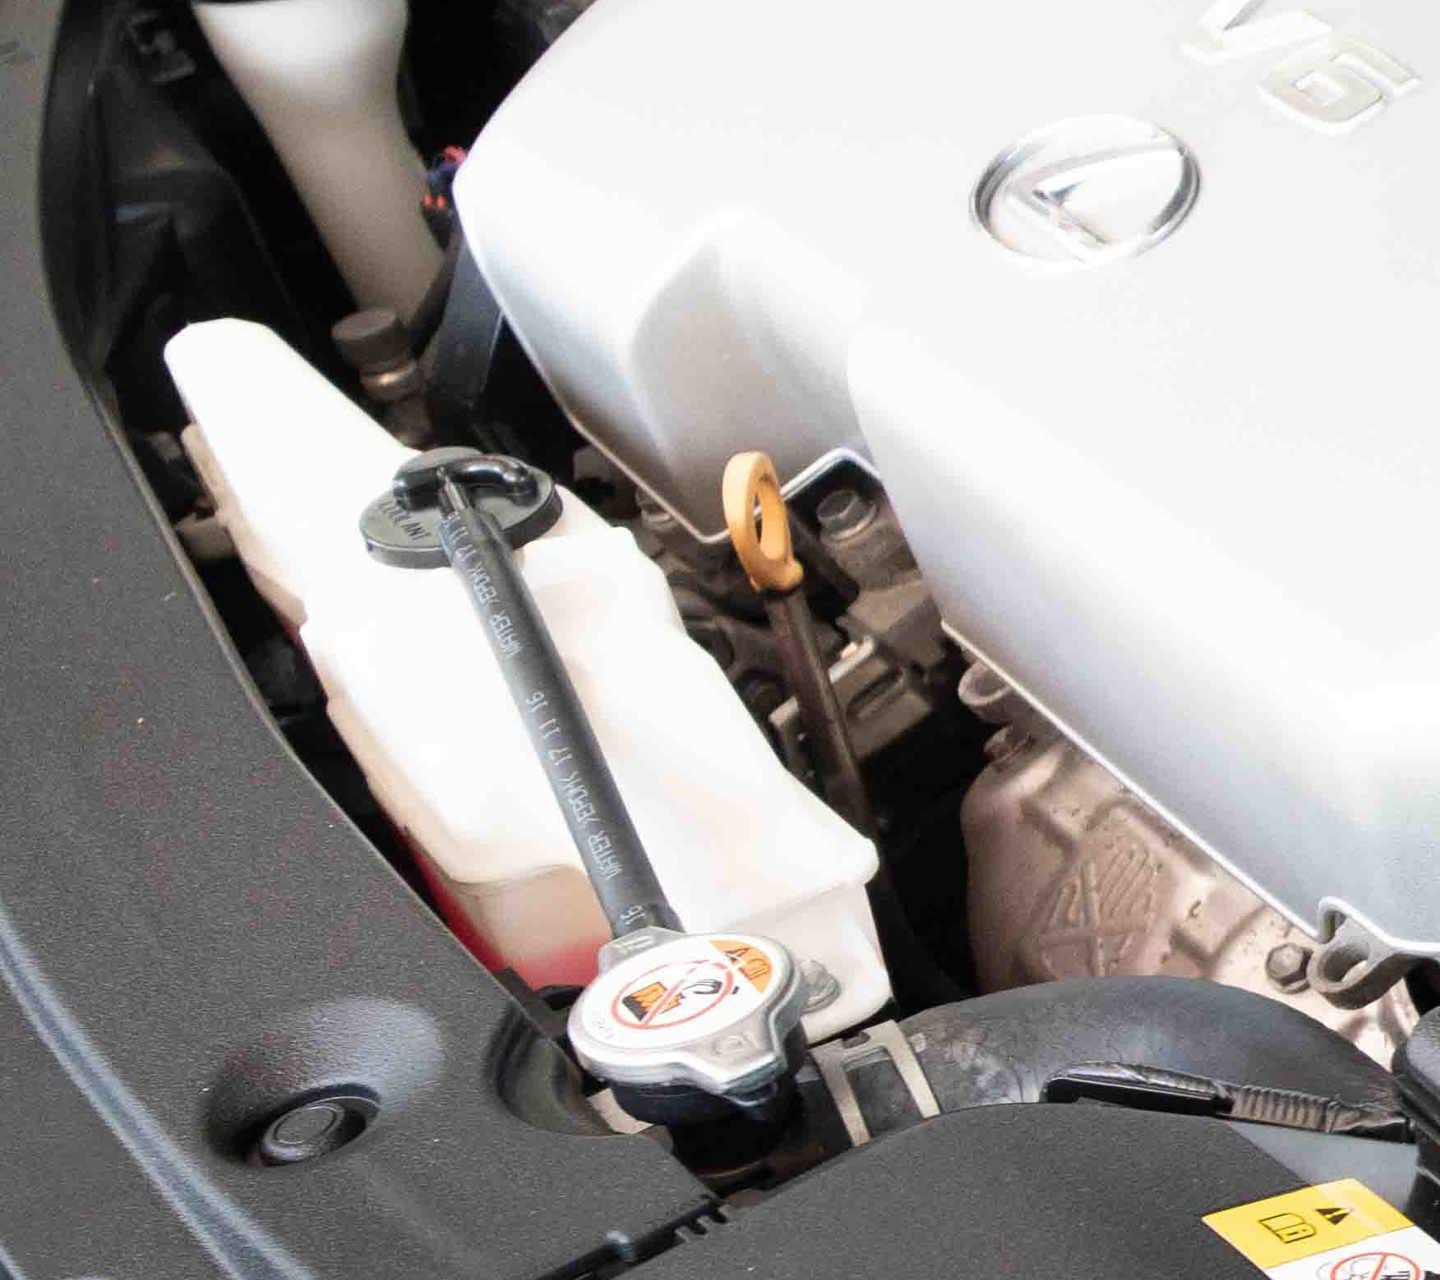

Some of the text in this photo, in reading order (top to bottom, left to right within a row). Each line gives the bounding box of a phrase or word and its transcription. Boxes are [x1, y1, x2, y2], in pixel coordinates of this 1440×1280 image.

[490, 611, 524, 657] WATER
[527, 690, 548, 712] 16
[548, 745, 572, 767] 17
[589, 830, 623, 881] WATER
